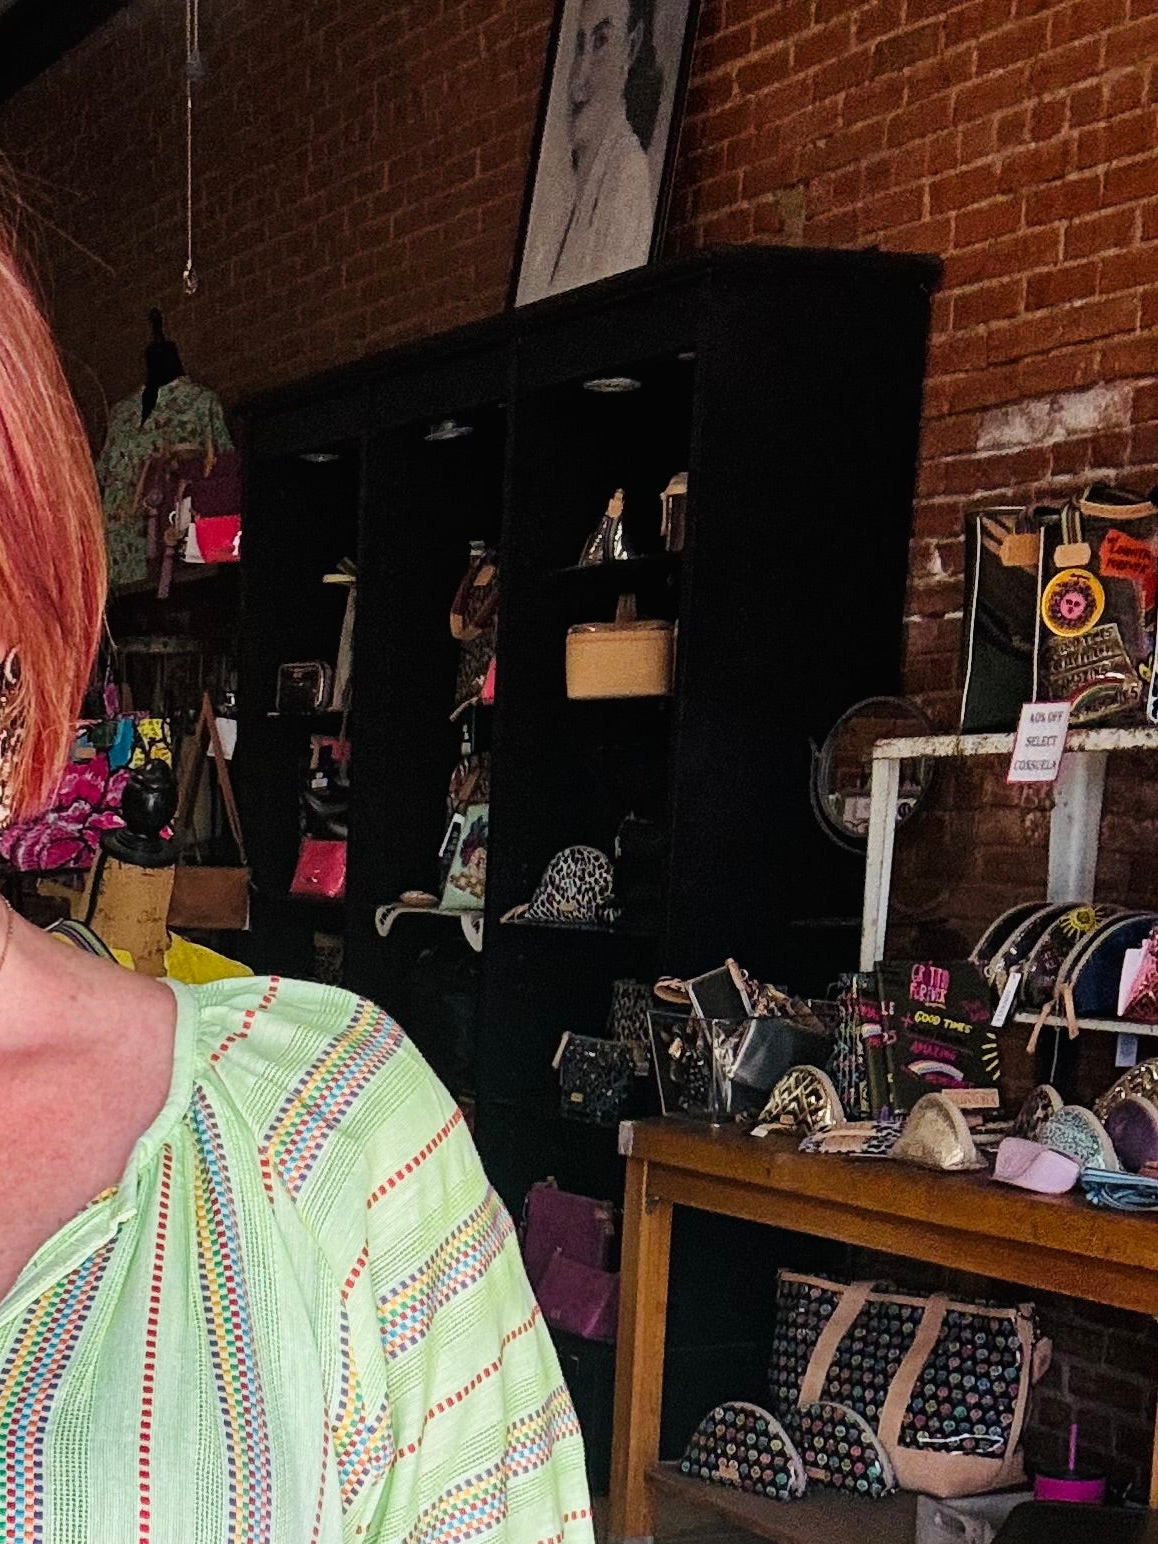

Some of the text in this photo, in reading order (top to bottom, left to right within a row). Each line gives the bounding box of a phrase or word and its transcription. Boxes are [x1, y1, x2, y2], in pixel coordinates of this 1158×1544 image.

[1025, 735, 1058, 747] SELECT
[914, 1011, 972, 1034] GOOD TIMES
